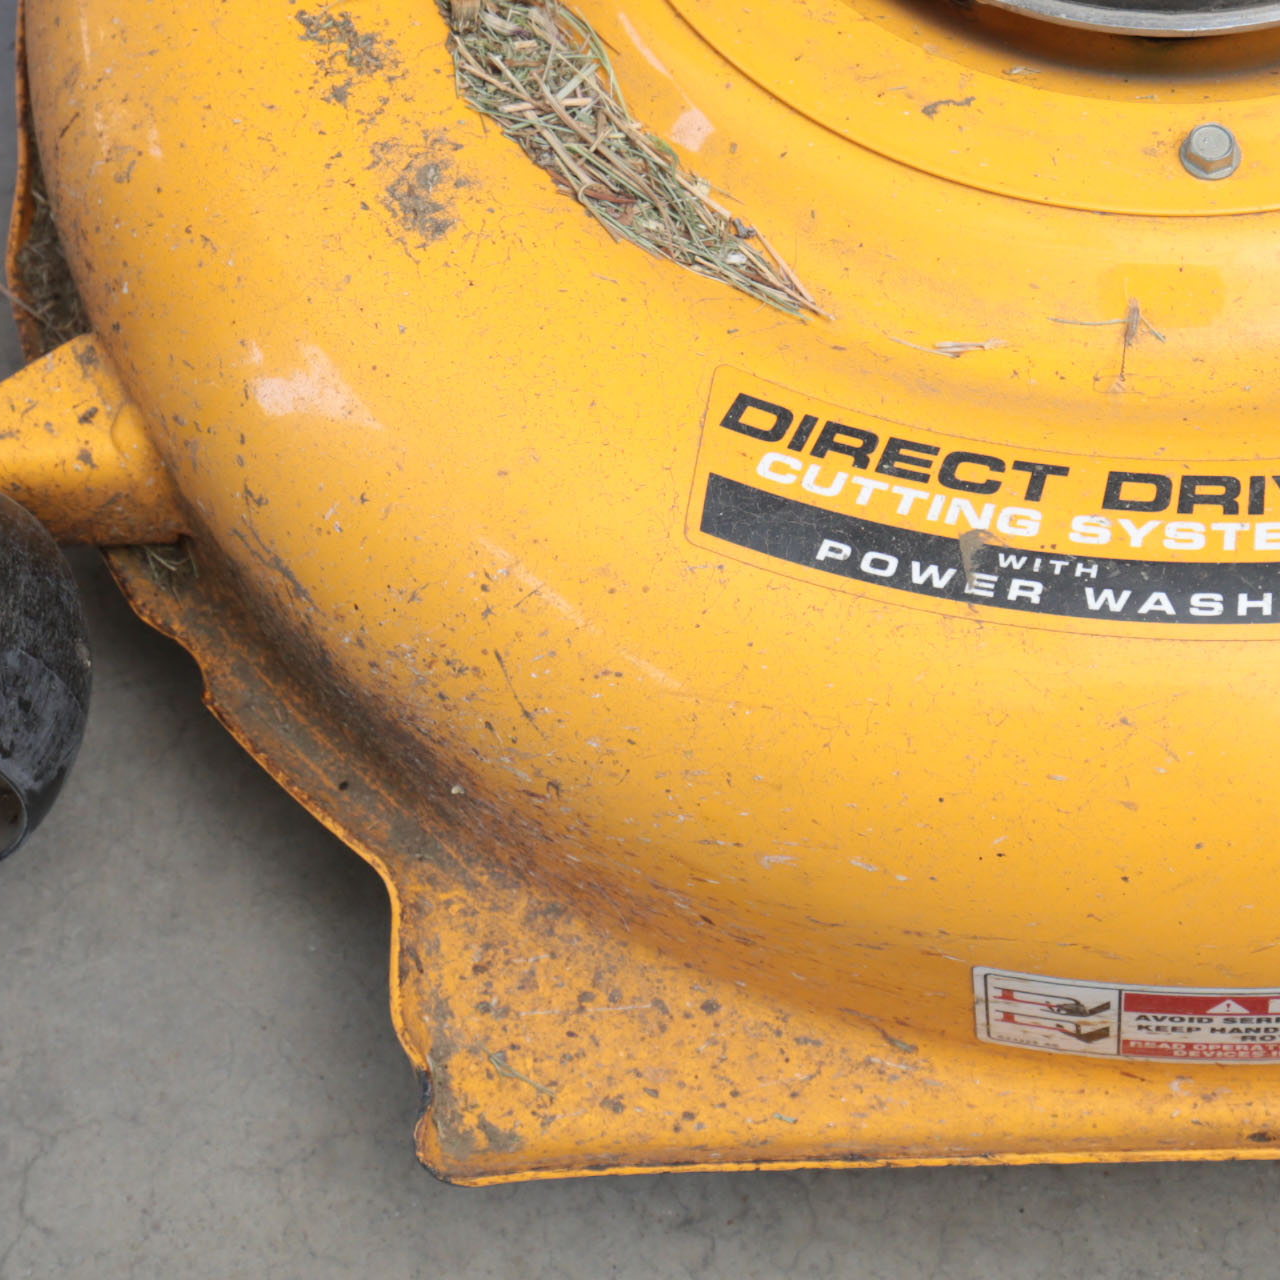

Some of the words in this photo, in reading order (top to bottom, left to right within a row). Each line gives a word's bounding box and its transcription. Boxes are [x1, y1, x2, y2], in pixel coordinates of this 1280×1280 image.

[720, 393, 1069, 502] DIRECT
[756, 452, 1040, 537] CUTTING
[815, 539, 1042, 605] POWER
[1086, 586, 1273, 617] WASH
[998, 552, 1100, 579] WITH
[1135, 1015, 1213, 1024] AVOID
[1137, 1024, 1202, 1033] KEEP
